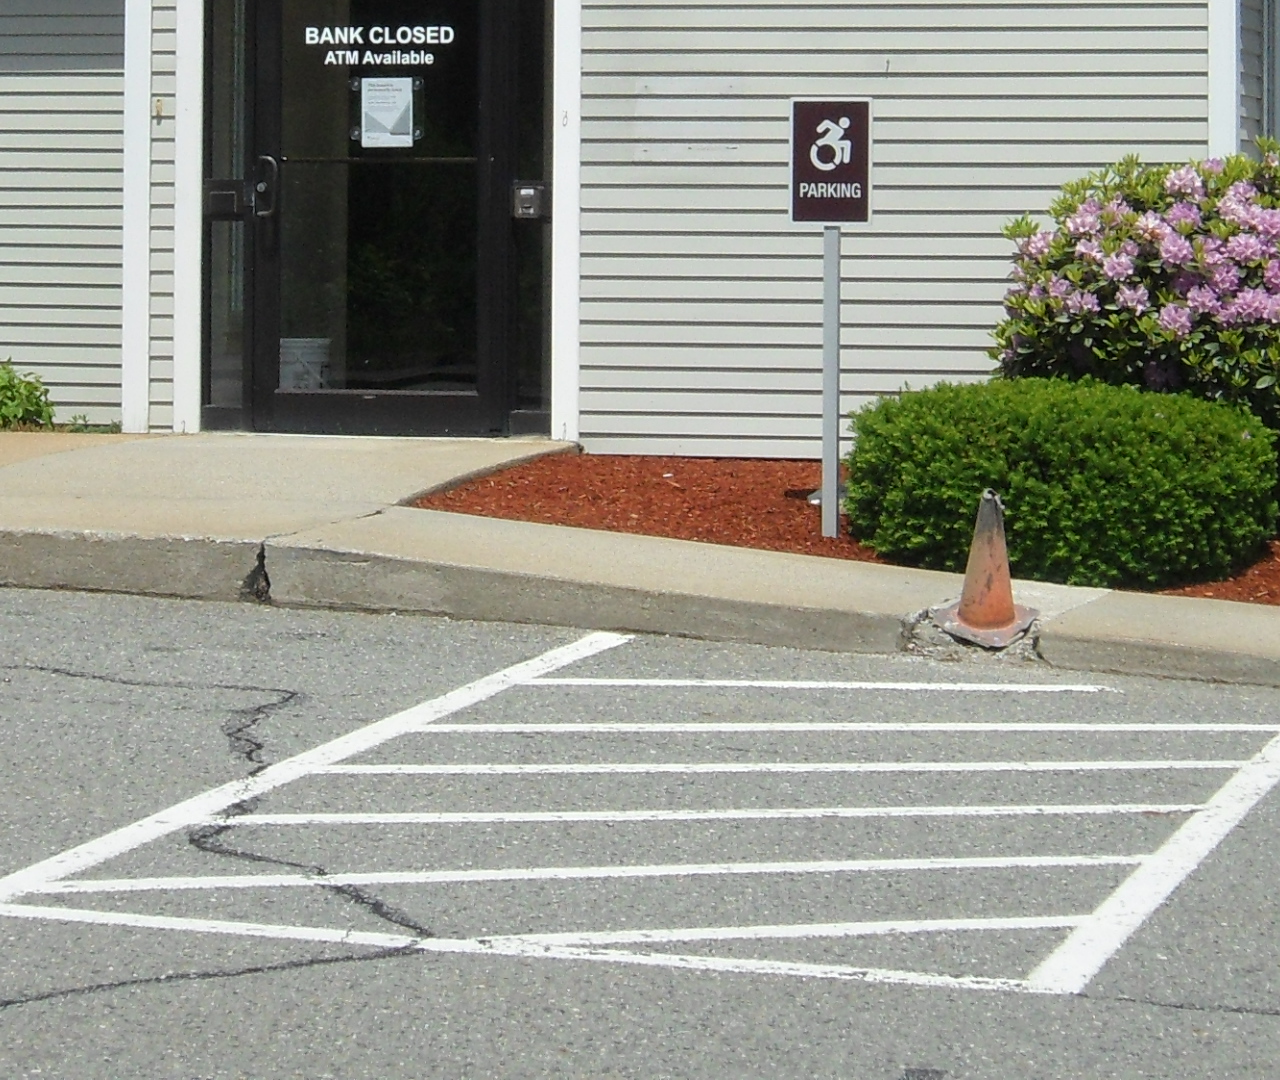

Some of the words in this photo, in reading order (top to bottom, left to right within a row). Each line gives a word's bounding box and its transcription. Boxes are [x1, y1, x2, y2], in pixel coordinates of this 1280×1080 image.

[305, 26, 364, 45] BANK
[369, 26, 455, 45] CLOSED
[324, 50, 359, 65] ATM
[362, 50, 435, 65] Available
[799, 182, 862, 199] PARKING
